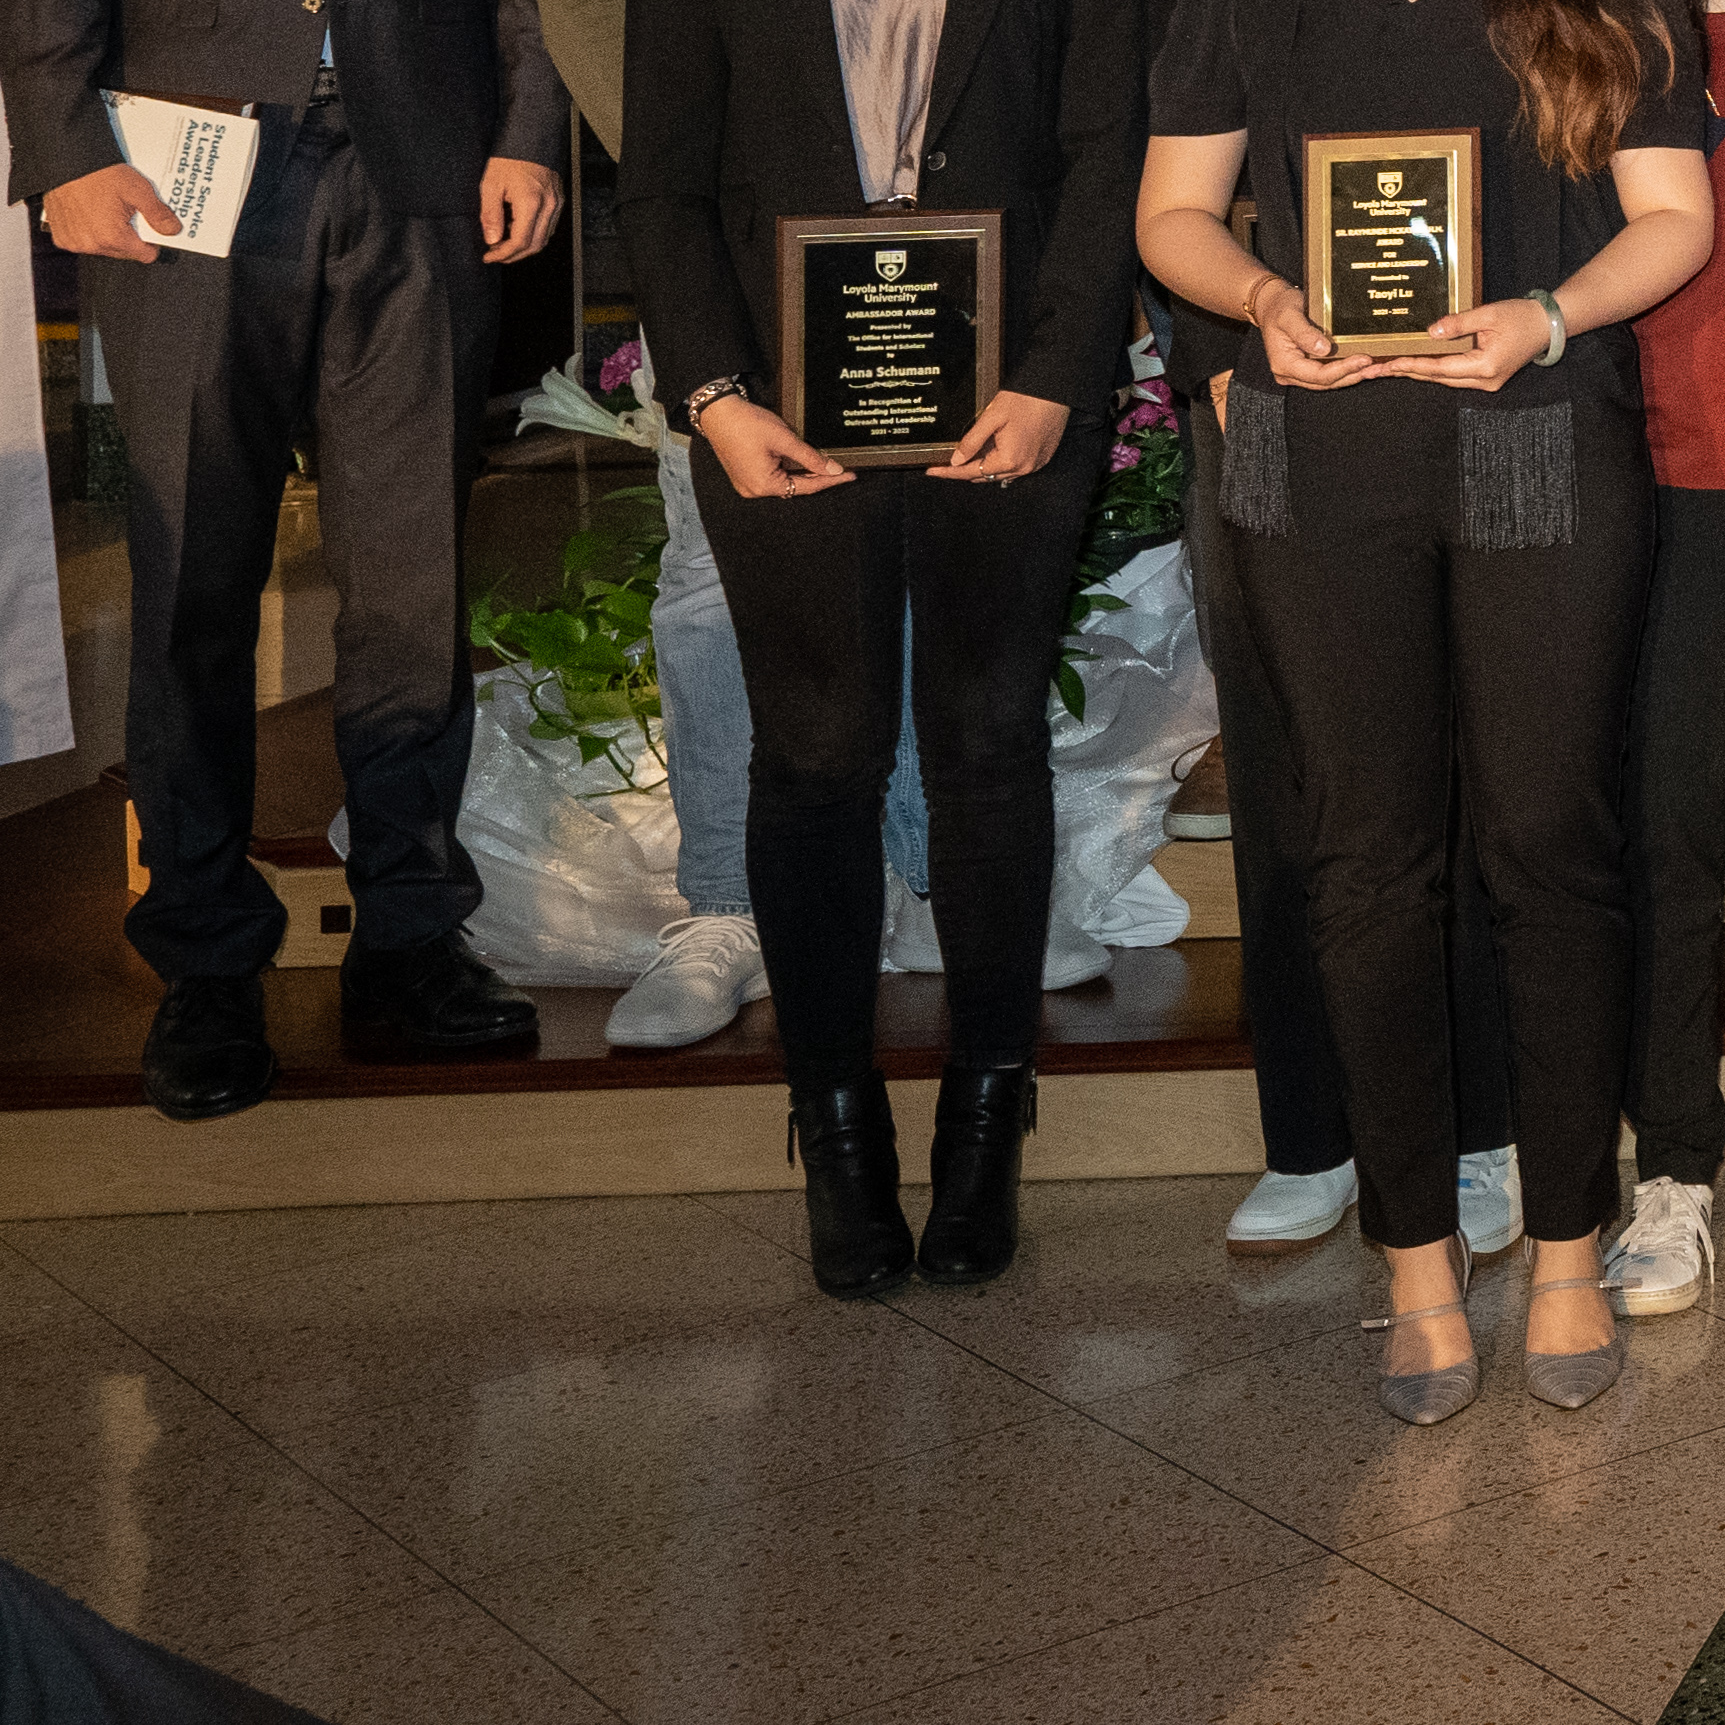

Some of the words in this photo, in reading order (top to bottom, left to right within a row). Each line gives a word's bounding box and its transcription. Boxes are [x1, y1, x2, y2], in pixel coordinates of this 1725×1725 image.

[201, 122, 213, 132] &
[177, 120, 199, 174] Awards
[205, 125, 226, 183] Student
[179, 137, 209, 218] Leadership
[188, 186, 212, 238] Service
[842, 283, 877, 294] Loyola
[878, 282, 938, 292] Marymount
[864, 292, 917, 303] University
[845, 309, 903, 319] AMBASSADOR
[904, 308, 936, 316] AWARD
[839, 368, 873, 379] Anna
[876, 365, 940, 377] Schumann
[868, 397, 912, 406] Recognition
[842, 408, 888, 416] Outstanding
[889, 405, 937, 414] International
[844, 418, 878, 426] Outreach
[895, 415, 936, 424] Leadership
